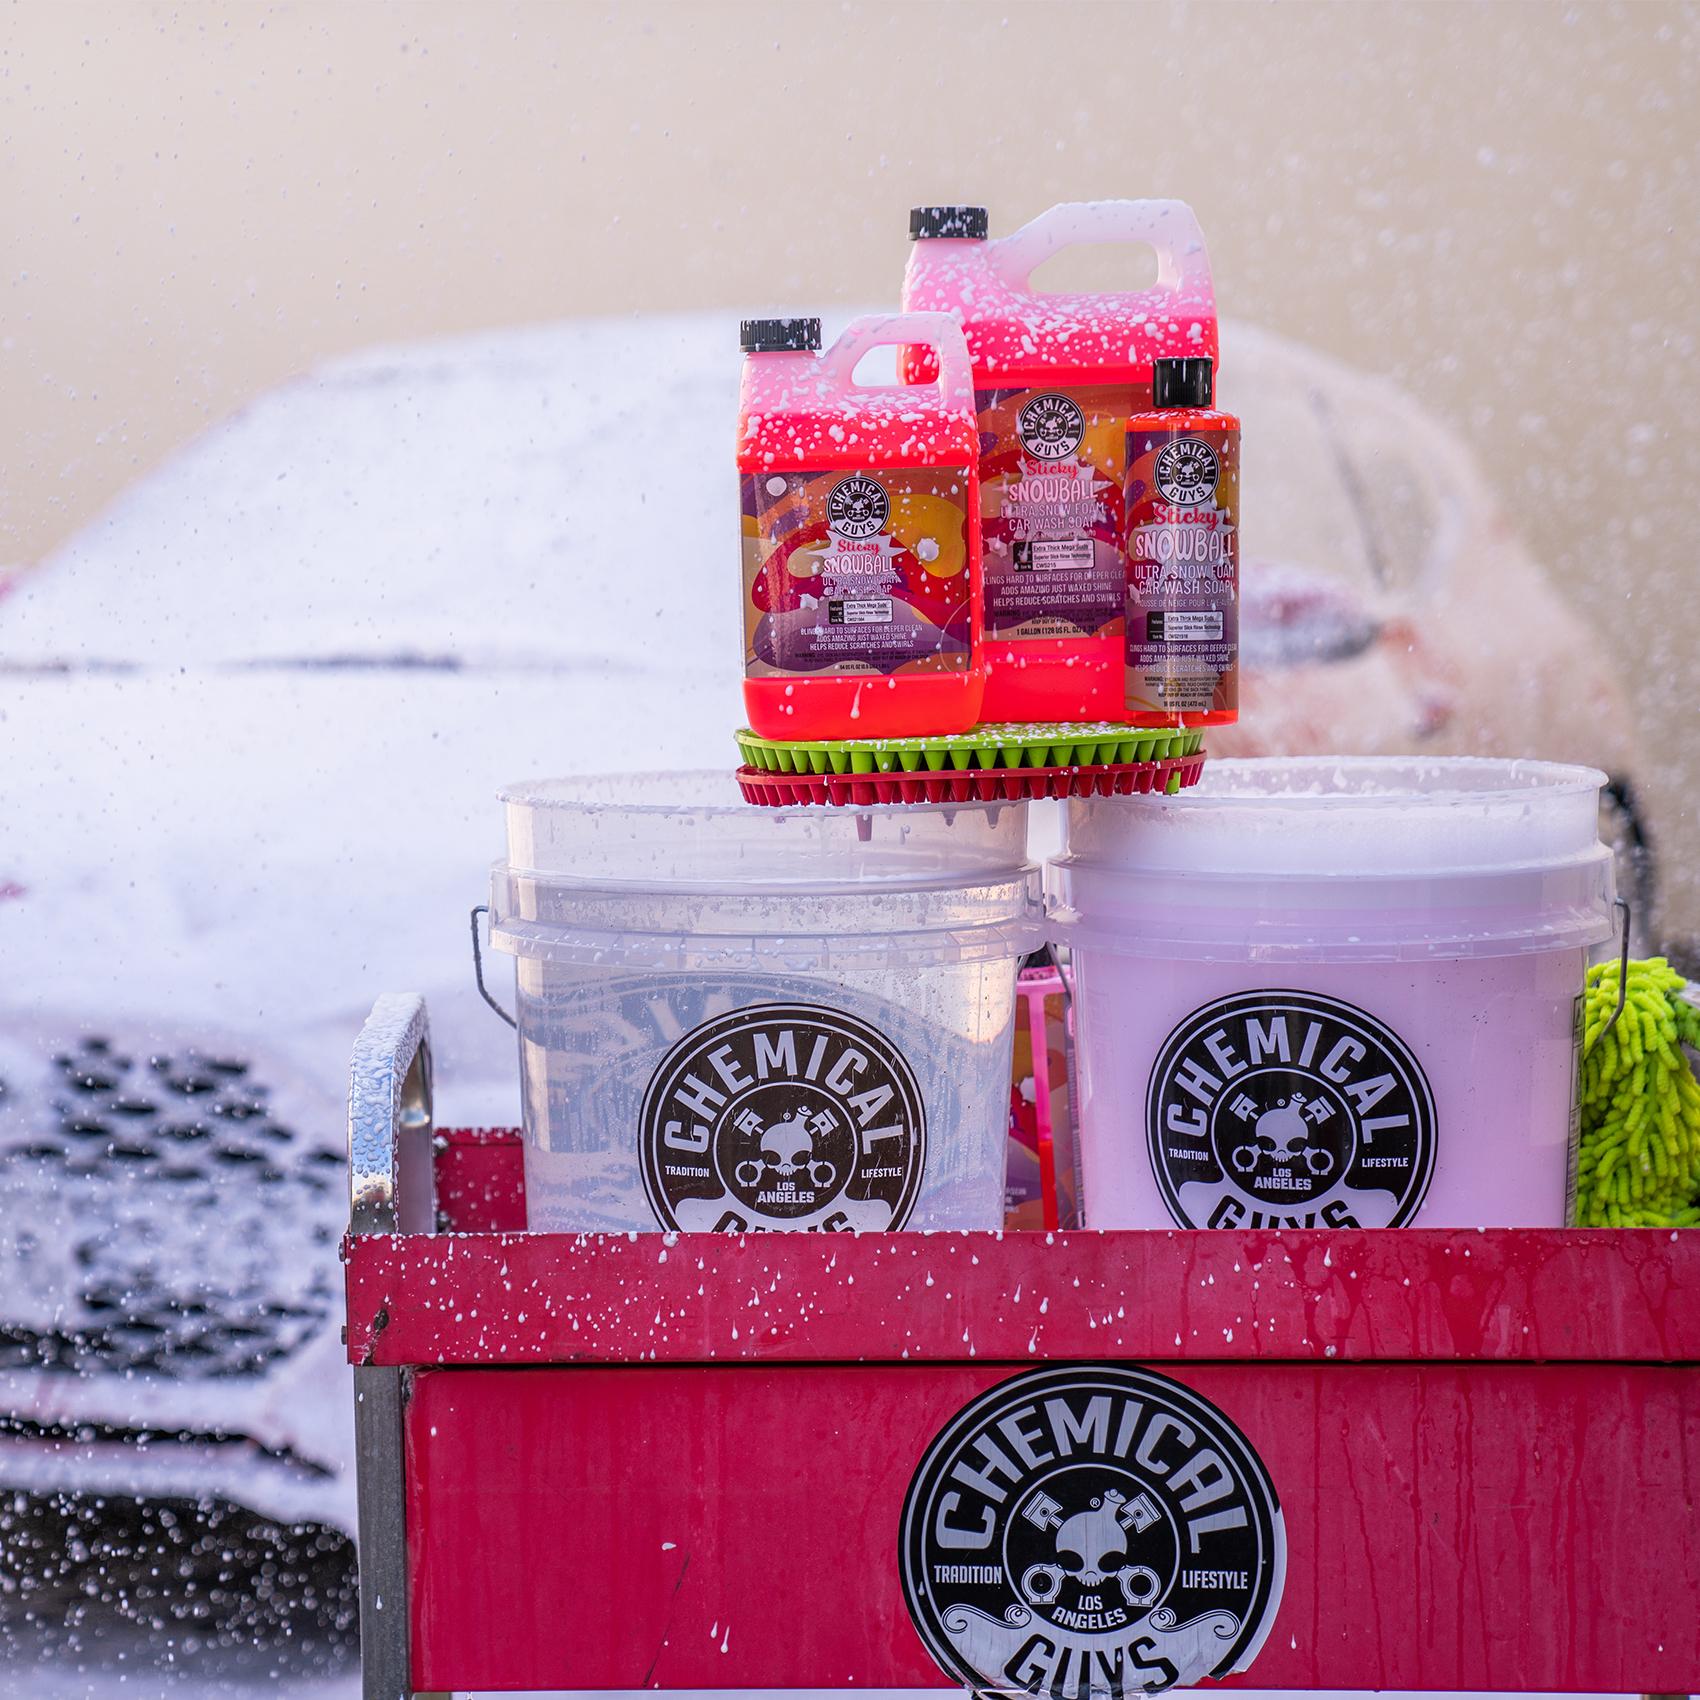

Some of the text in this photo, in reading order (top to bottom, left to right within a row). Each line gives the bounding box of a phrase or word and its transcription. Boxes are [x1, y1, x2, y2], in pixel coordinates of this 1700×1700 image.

[1023, 398, 1079, 430] CHEMICAL
[1034, 440, 1070, 456] GUYS
[1160, 443, 1215, 474] CHEMICAL
[1025, 460, 1078, 479] Sticky
[832, 481, 885, 510] CHEMICAL
[1008, 478, 1099, 504] SNOWBALL
[1169, 487, 1206, 501] GUYS
[1001, 502, 1105, 519] ULTRA SNOW FOAM
[1153, 503, 1218, 531] Sticky
[842, 521, 876, 535] GUYS
[1008, 519, 1030, 531] CAR
[1035, 517, 1065, 529] WASH
[1135, 529, 1235, 562] SNOWBALL
[823, 554, 897, 575] SNOWBALL
[1134, 564, 1235, 579] ULTRA SNOW FOAM
[1006, 575, 1025, 584] HARD
[1025, 574, 1033, 584] TO
[1035, 573, 1069, 583] SURFACES
[1070, 572, 1083, 581] FOR
[1001, 582, 1112, 595] ADDS AMAZING JUST WAXED SHINE
[1139, 580, 1231, 595] CAR WASH SOAP
[993, 598, 1015, 607] HELPS
[1015, 597, 1041, 606] REDUCE
[1042, 595, 1080, 605] SCRATCHES
[1081, 594, 1095, 603] AND
[843, 626, 871, 634] SURFACES
[872, 625, 882, 633] FOR
[905, 624, 923, 632] CLEAN
[831, 634, 856, 642] AMAZING
[869, 633, 890, 641] WAXED
[891, 632, 907, 640] SHINE
[809, 642, 827, 651] HELPS
[827, 642, 849, 650] REDUCE
[849, 641, 880, 649] SCRATCHES
[1166, 644, 1197, 653] SURFACES
[1198, 644, 1209, 652] FOR
[1166, 1015, 1410, 1145] CHEMICAL
[663, 1030, 904, 1155] CHEMICAL
[1168, 1148, 1209, 1162] TRADITION
[1361, 1157, 1409, 1168] LIFESTYLE
[665, 1165, 710, 1178] TRADITION
[861, 1167, 903, 1179] LIFESTYLE
[1272, 1168, 1292, 1178] LOS
[776, 1181, 796, 1192] LOS
[1254, 1177, 1312, 1191] ANGELES
[757, 1190, 815, 1204] ANGELES
[935, 1395, 1249, 1555] CHEMICAL
[934, 1564, 1003, 1585] TRADITION
[1181, 1569, 1249, 1590] LIFESTYLE
[1077, 1594, 1104, 1611] LOS
[1051, 1607, 1128, 1630] ANGELES
[1003, 1632, 1180, 1700] GUYS
